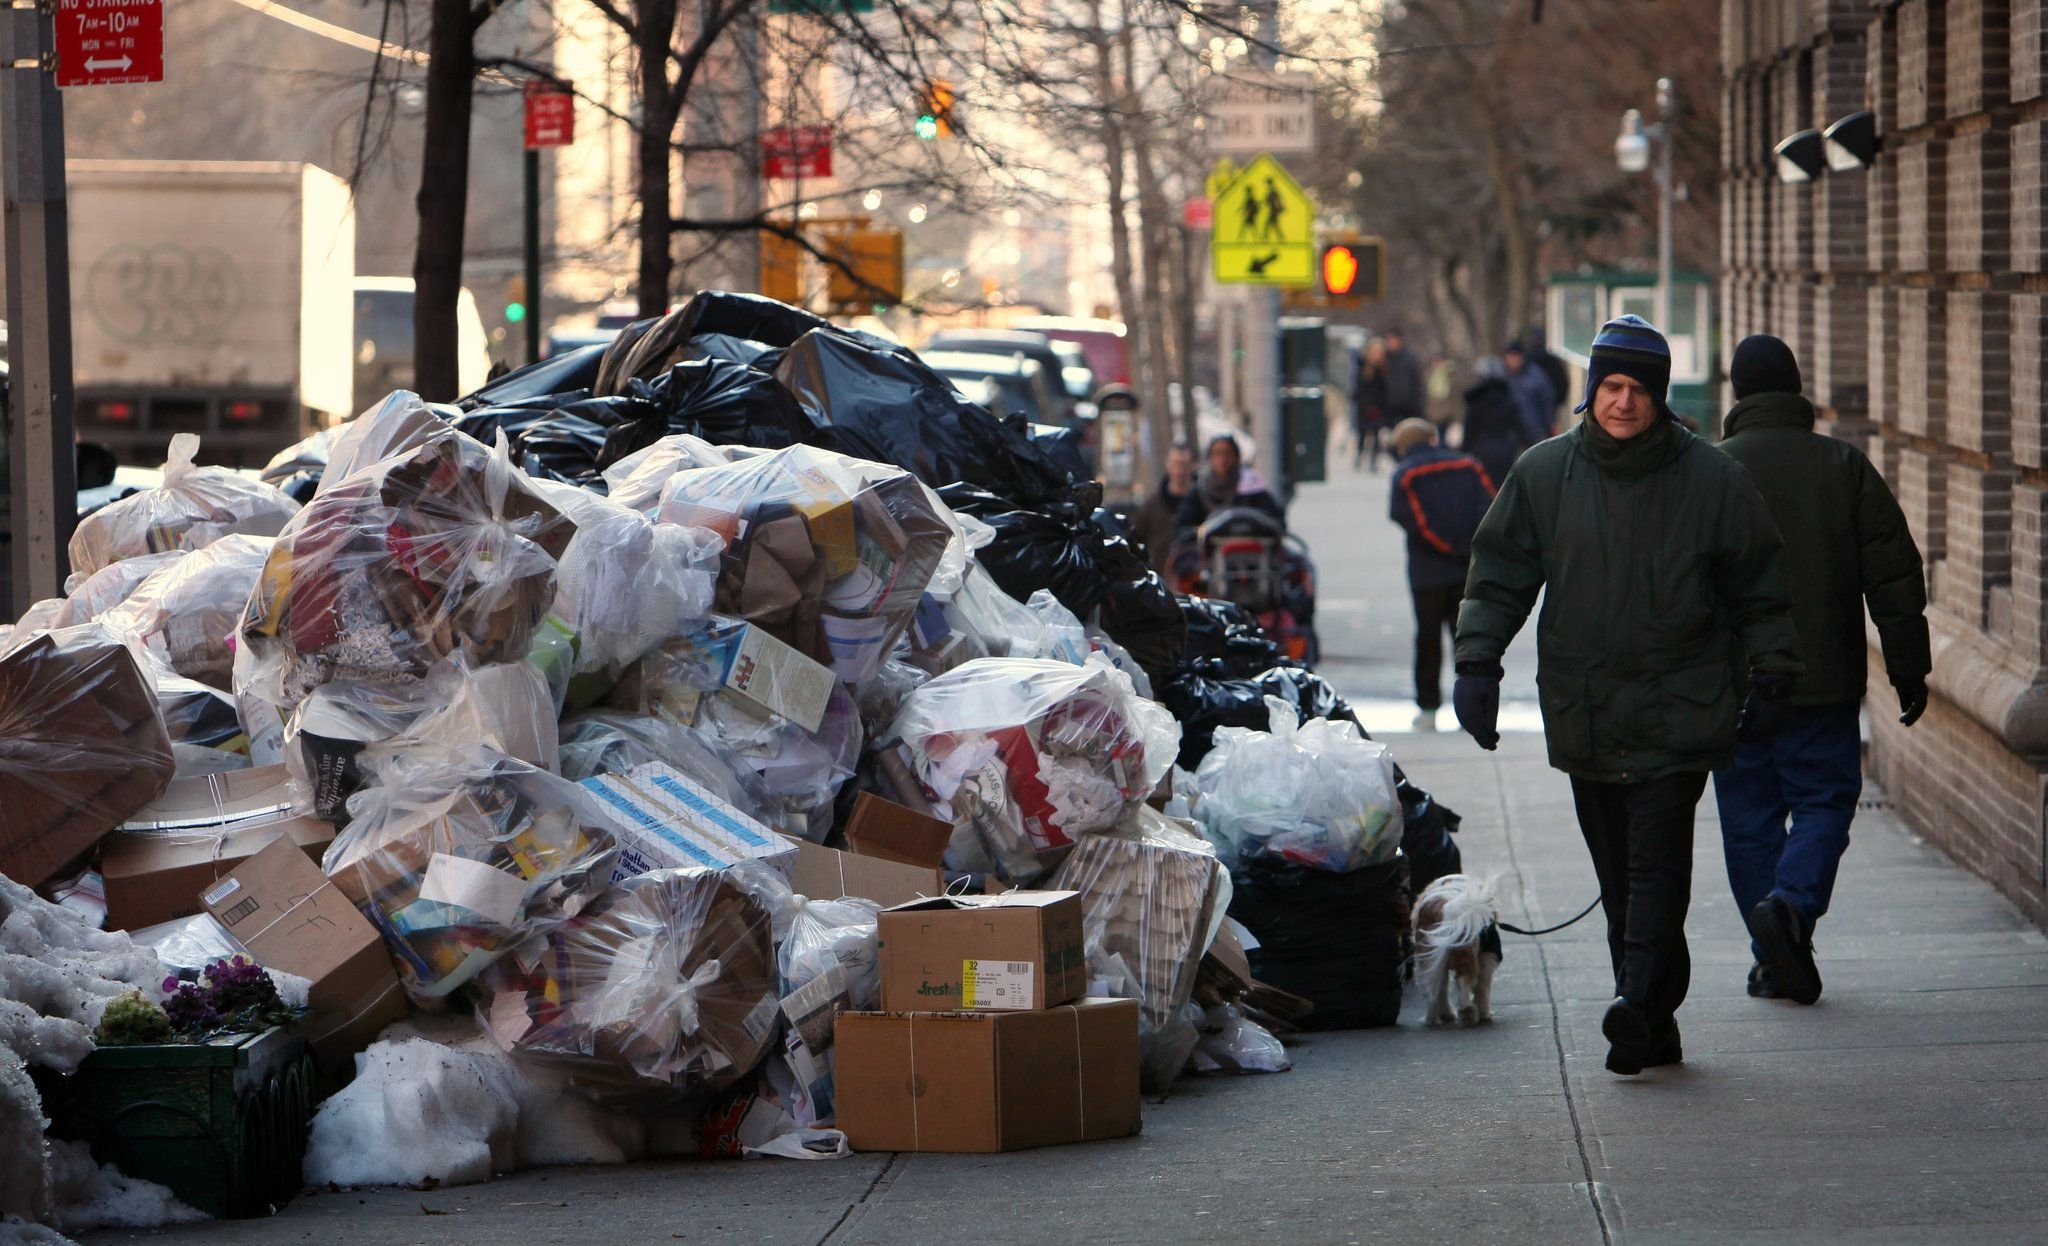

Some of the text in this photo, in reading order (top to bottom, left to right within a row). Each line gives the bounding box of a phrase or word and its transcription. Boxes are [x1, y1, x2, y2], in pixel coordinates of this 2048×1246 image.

[81, 39, 100, 51] MON
[120, 37, 135, 49] FRI
[968, 961, 978, 970] 32
